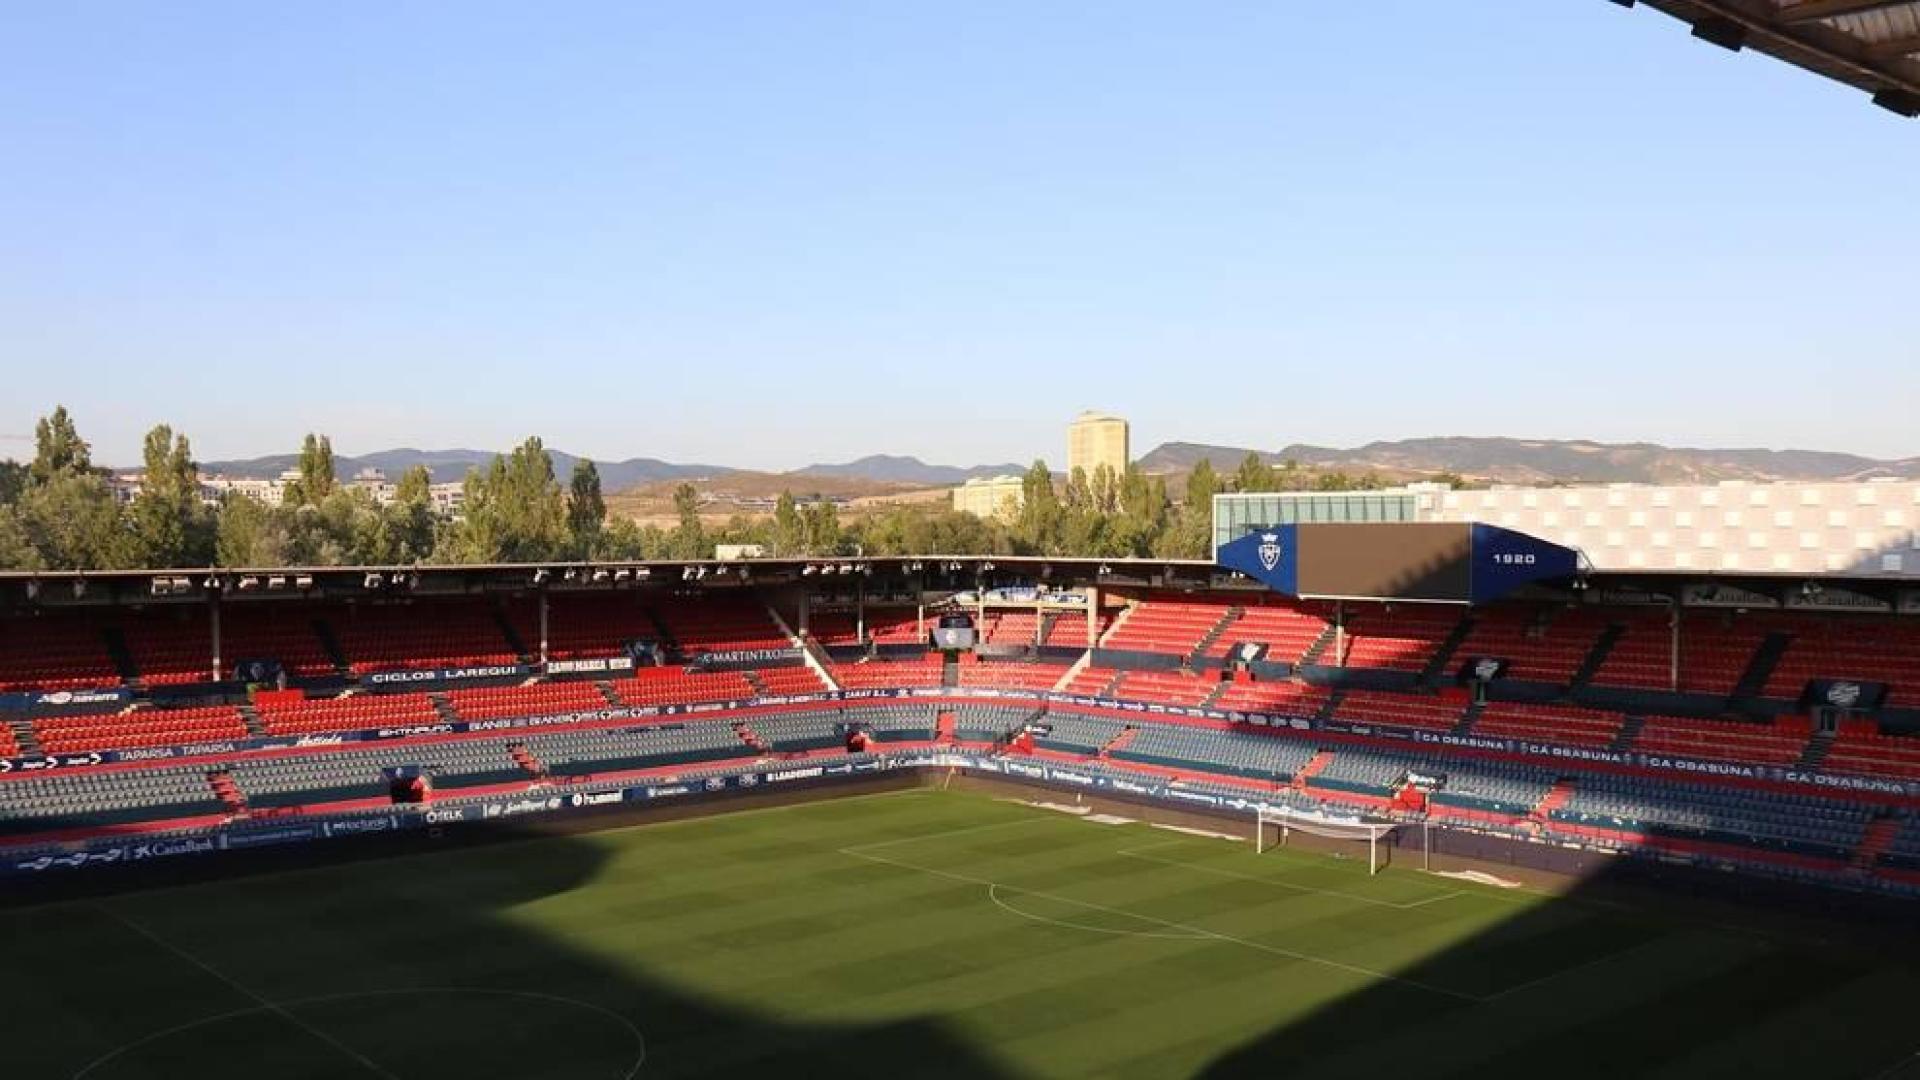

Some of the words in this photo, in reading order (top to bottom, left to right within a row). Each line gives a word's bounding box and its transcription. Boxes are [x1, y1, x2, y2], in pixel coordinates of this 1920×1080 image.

[1493, 554, 1534, 565] 1920
[371, 671, 435, 683] CICLOS
[1423, 734, 1439, 743] CA
[1442, 736, 1504, 750] OSASUNA
[1530, 744, 1548, 754] CA
[1553, 748, 1621, 762] OSASUNA
[1650, 757, 1671, 768] CA
[1676, 760, 1752, 777] OSASUNA
[1786, 771, 1811, 783] CA
[1815, 775, 1904, 793] OSASUNA
